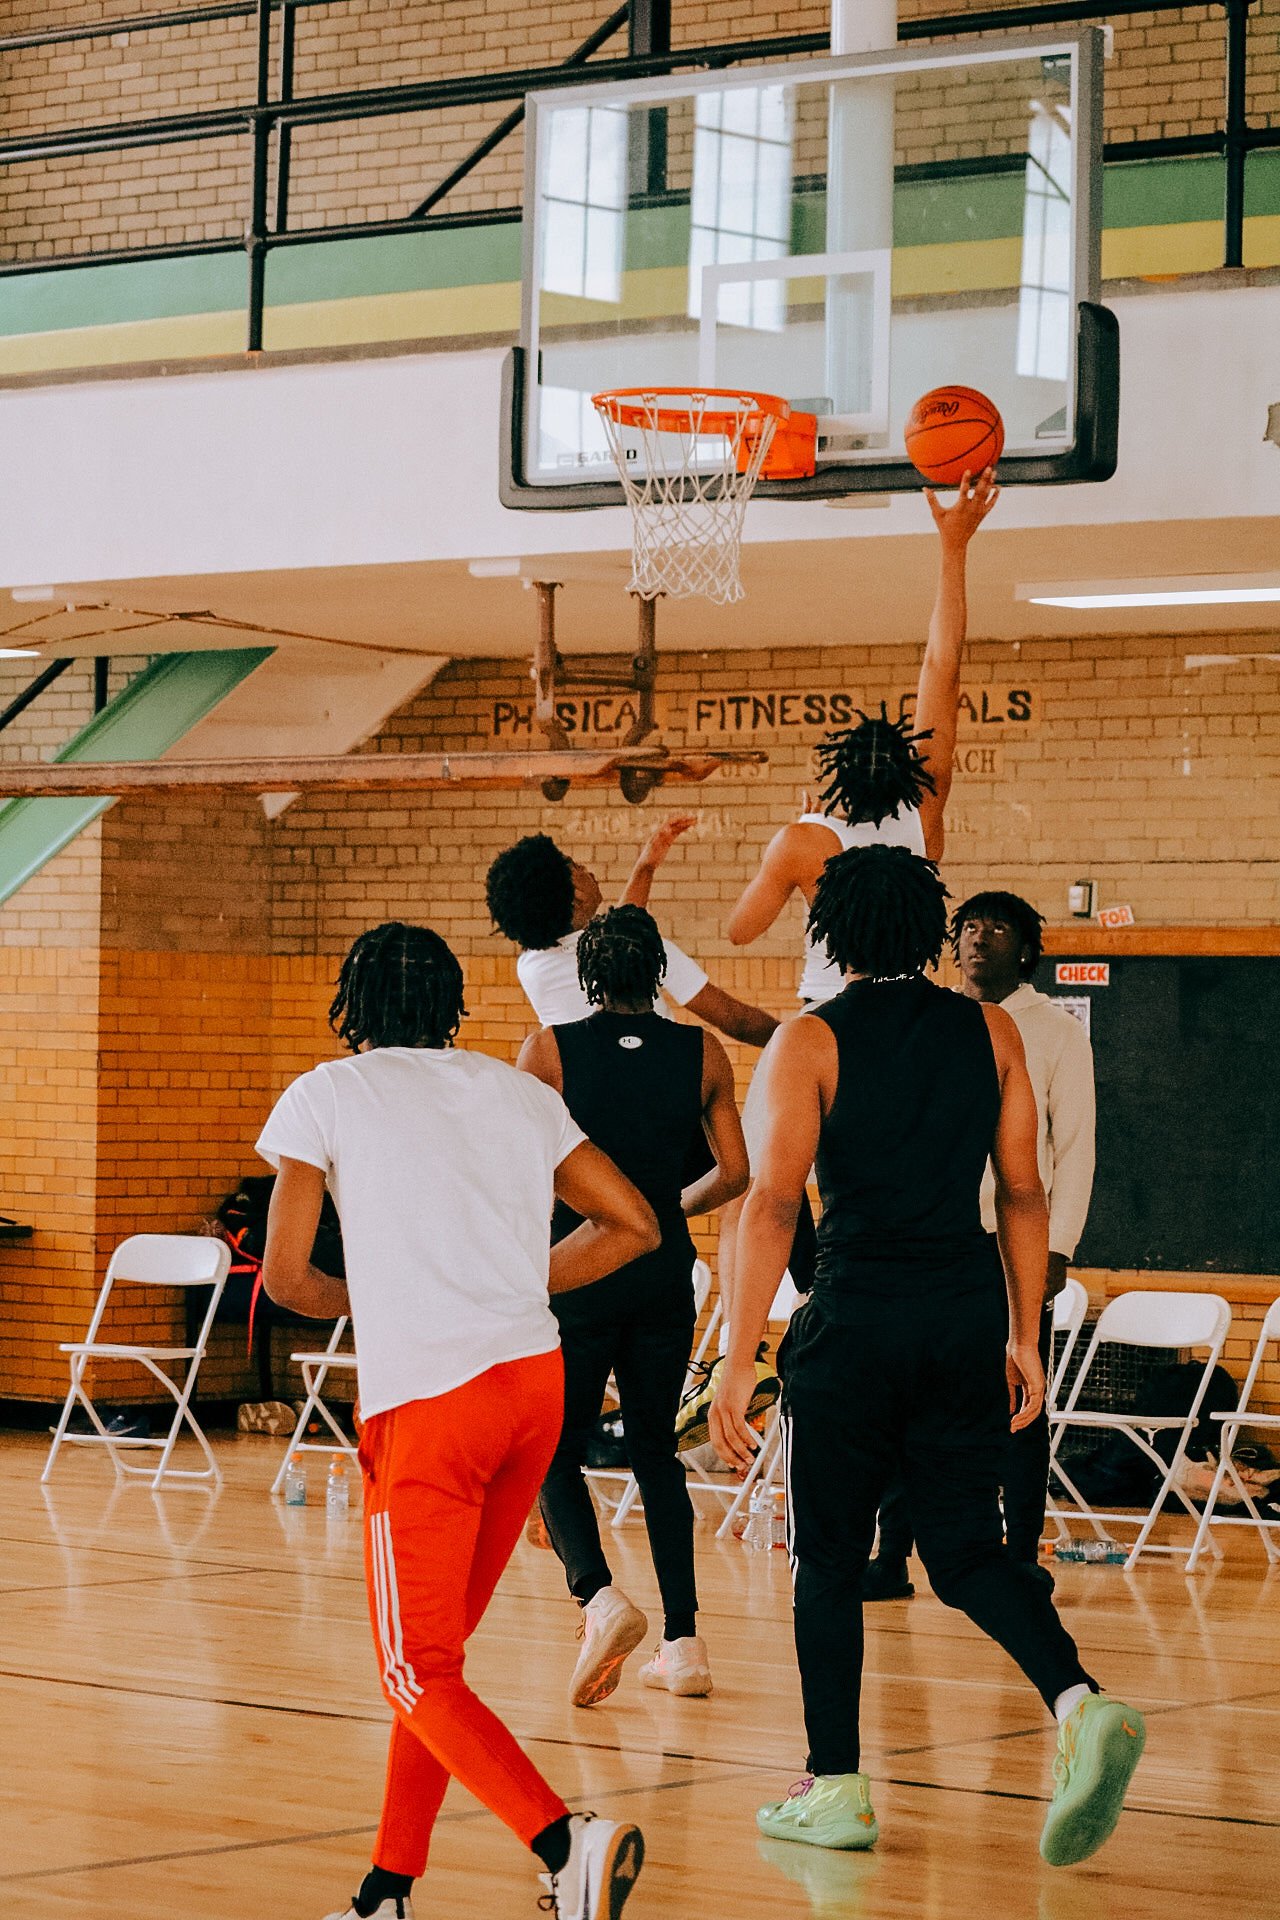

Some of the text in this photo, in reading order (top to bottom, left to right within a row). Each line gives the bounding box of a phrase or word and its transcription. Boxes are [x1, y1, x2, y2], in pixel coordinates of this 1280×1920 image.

[577, 448, 638, 463] GARD
[493, 690, 1031, 735] PHSICA FITNESS ALS
[1100, 908, 1129, 926] FOR
[1058, 966, 1107, 982] CHECK
